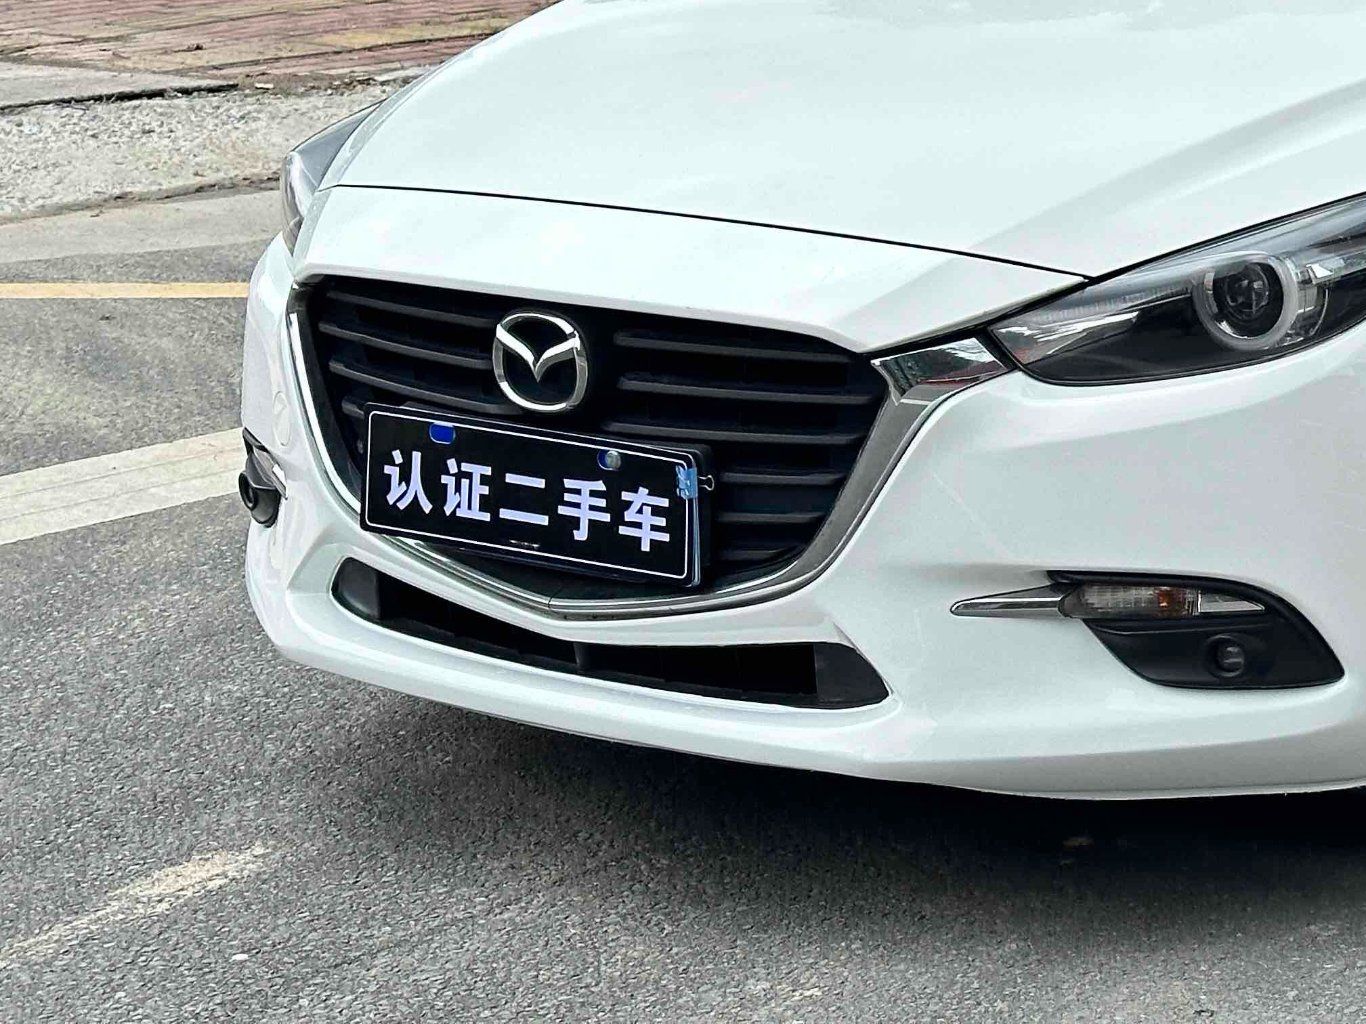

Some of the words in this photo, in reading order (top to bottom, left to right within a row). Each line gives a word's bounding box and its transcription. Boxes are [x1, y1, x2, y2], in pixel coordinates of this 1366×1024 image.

[383, 448, 671, 553] 认证二手车
